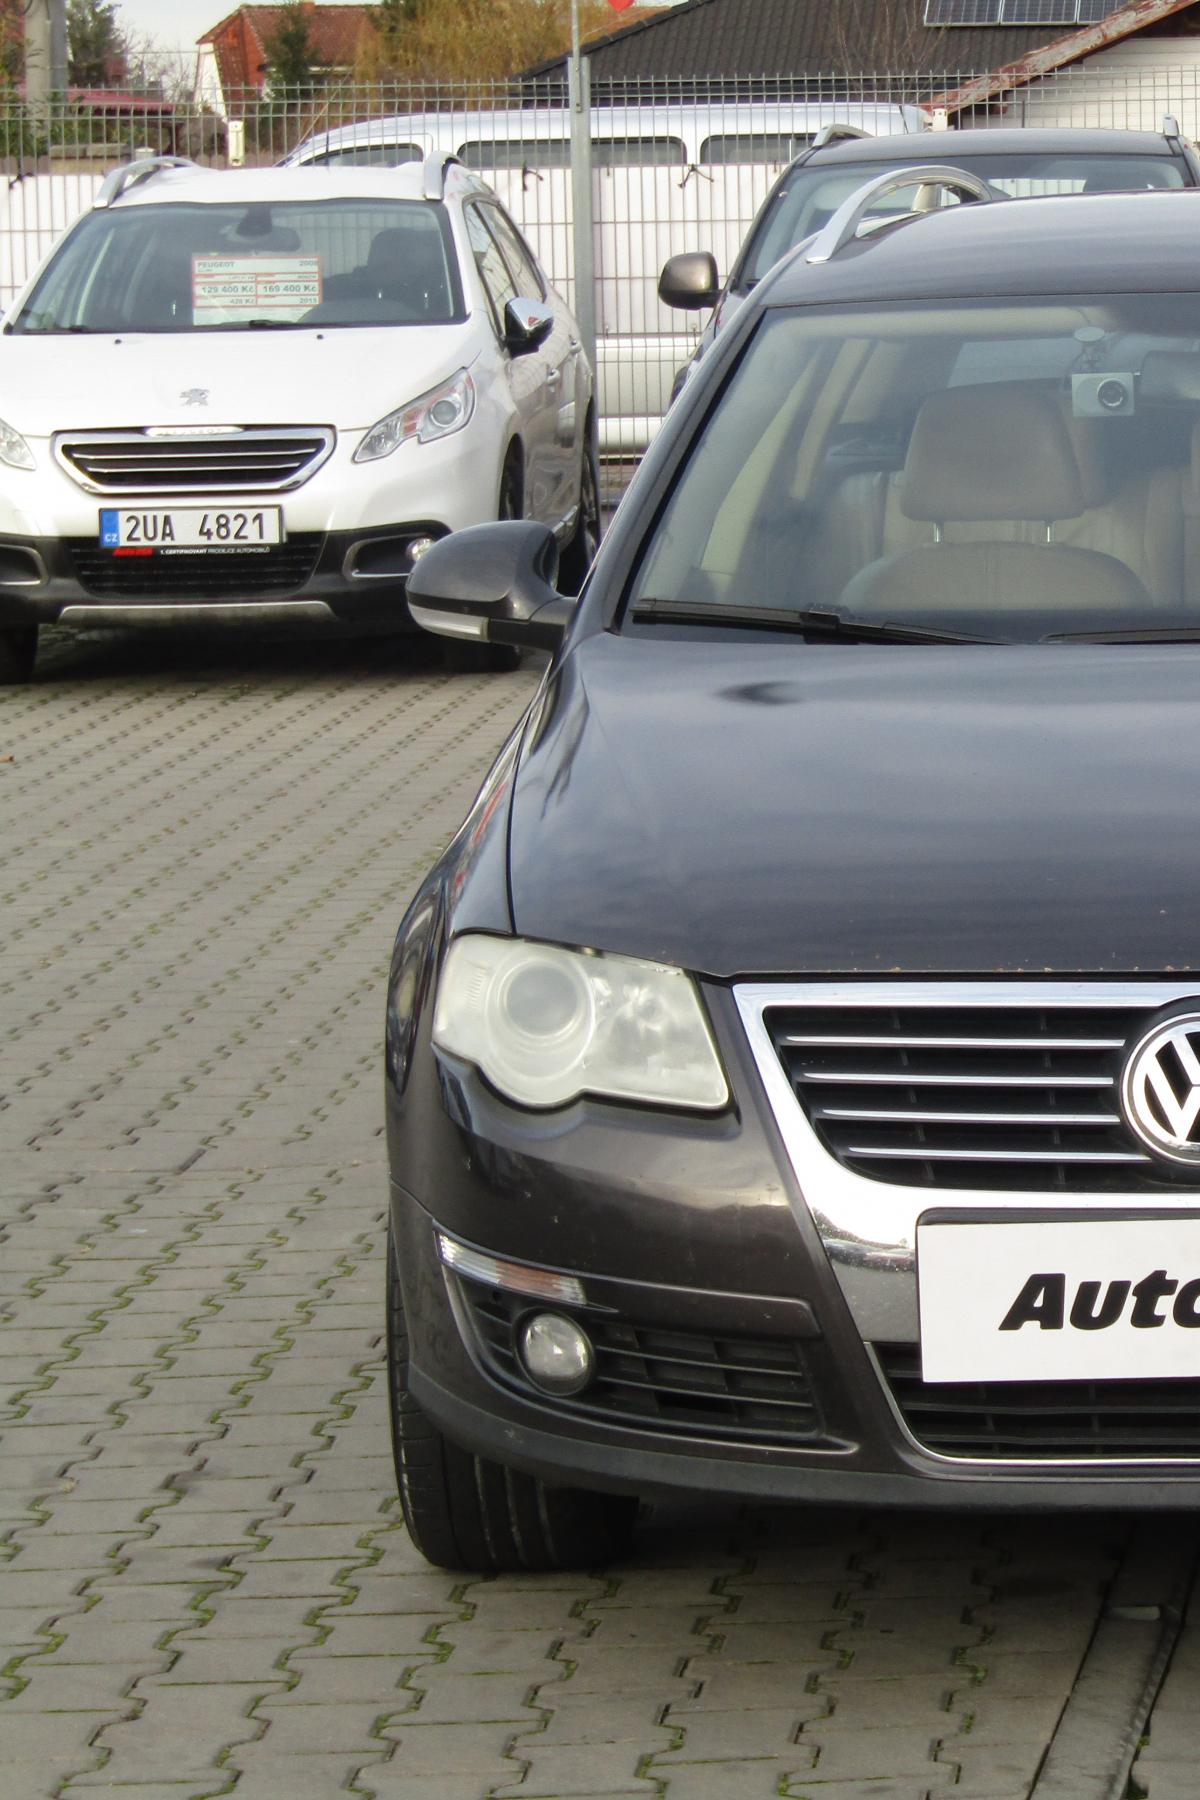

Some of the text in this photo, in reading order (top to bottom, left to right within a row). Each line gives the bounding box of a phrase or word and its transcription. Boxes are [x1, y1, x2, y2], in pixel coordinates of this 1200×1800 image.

[222, 285, 239, 293] 400
[283, 284, 301, 292] 400
[126, 513, 264, 542] 2UA 4821
[105, 533, 118, 542] CZ
